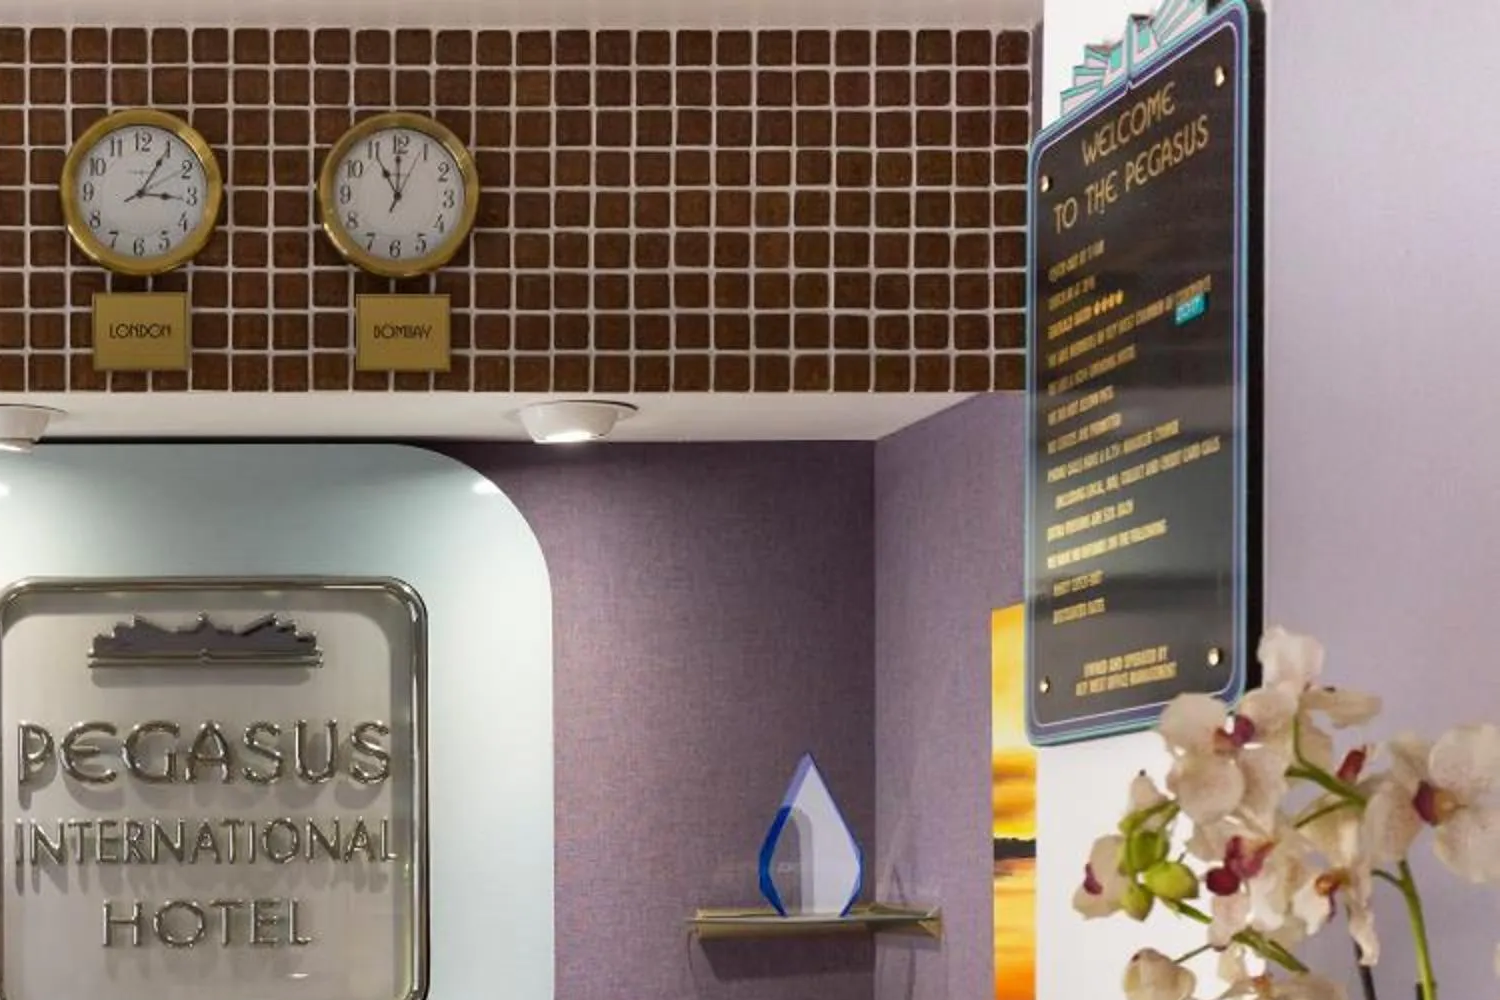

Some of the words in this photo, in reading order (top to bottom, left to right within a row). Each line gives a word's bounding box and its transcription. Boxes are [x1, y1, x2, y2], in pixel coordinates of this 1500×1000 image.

[1082, 82, 1176, 166] WELCOME
[111, 137, 122, 157] 11
[135, 132, 152, 152] 12
[368, 141, 380, 159] 11
[393, 135, 409, 154] 12
[90, 158, 106, 176] 10
[181, 160, 193, 179] 2
[347, 160, 363, 178] 10
[438, 162, 449, 182] 2
[1053, 198, 1077, 235] TO
[1085, 170, 1118, 214] THE
[1125, 115, 1210, 192] PEGASUS
[83, 182, 94, 201] 9
[186, 187, 197, 206] 3
[340, 185, 351, 204] 9
[443, 190, 454, 209] 3
[90, 210, 101, 229] 8
[178, 212, 187, 231] 4
[347, 213, 358, 229] 8
[434, 214, 444, 233] 4
[109, 230, 118, 249] 7
[134, 238, 144, 256] 6
[159, 231, 170, 250] 5
[367, 232, 375, 250] 7
[389, 240, 400, 258] 6
[415, 233, 427, 253] 5
[109, 323, 172, 338] LONDON
[373, 324, 433, 339] BOMBAY
[17, 719, 392, 785] PEGASUS
[14, 817, 398, 866] INTERNATIONAL
[103, 899, 312, 947] HOTEL
